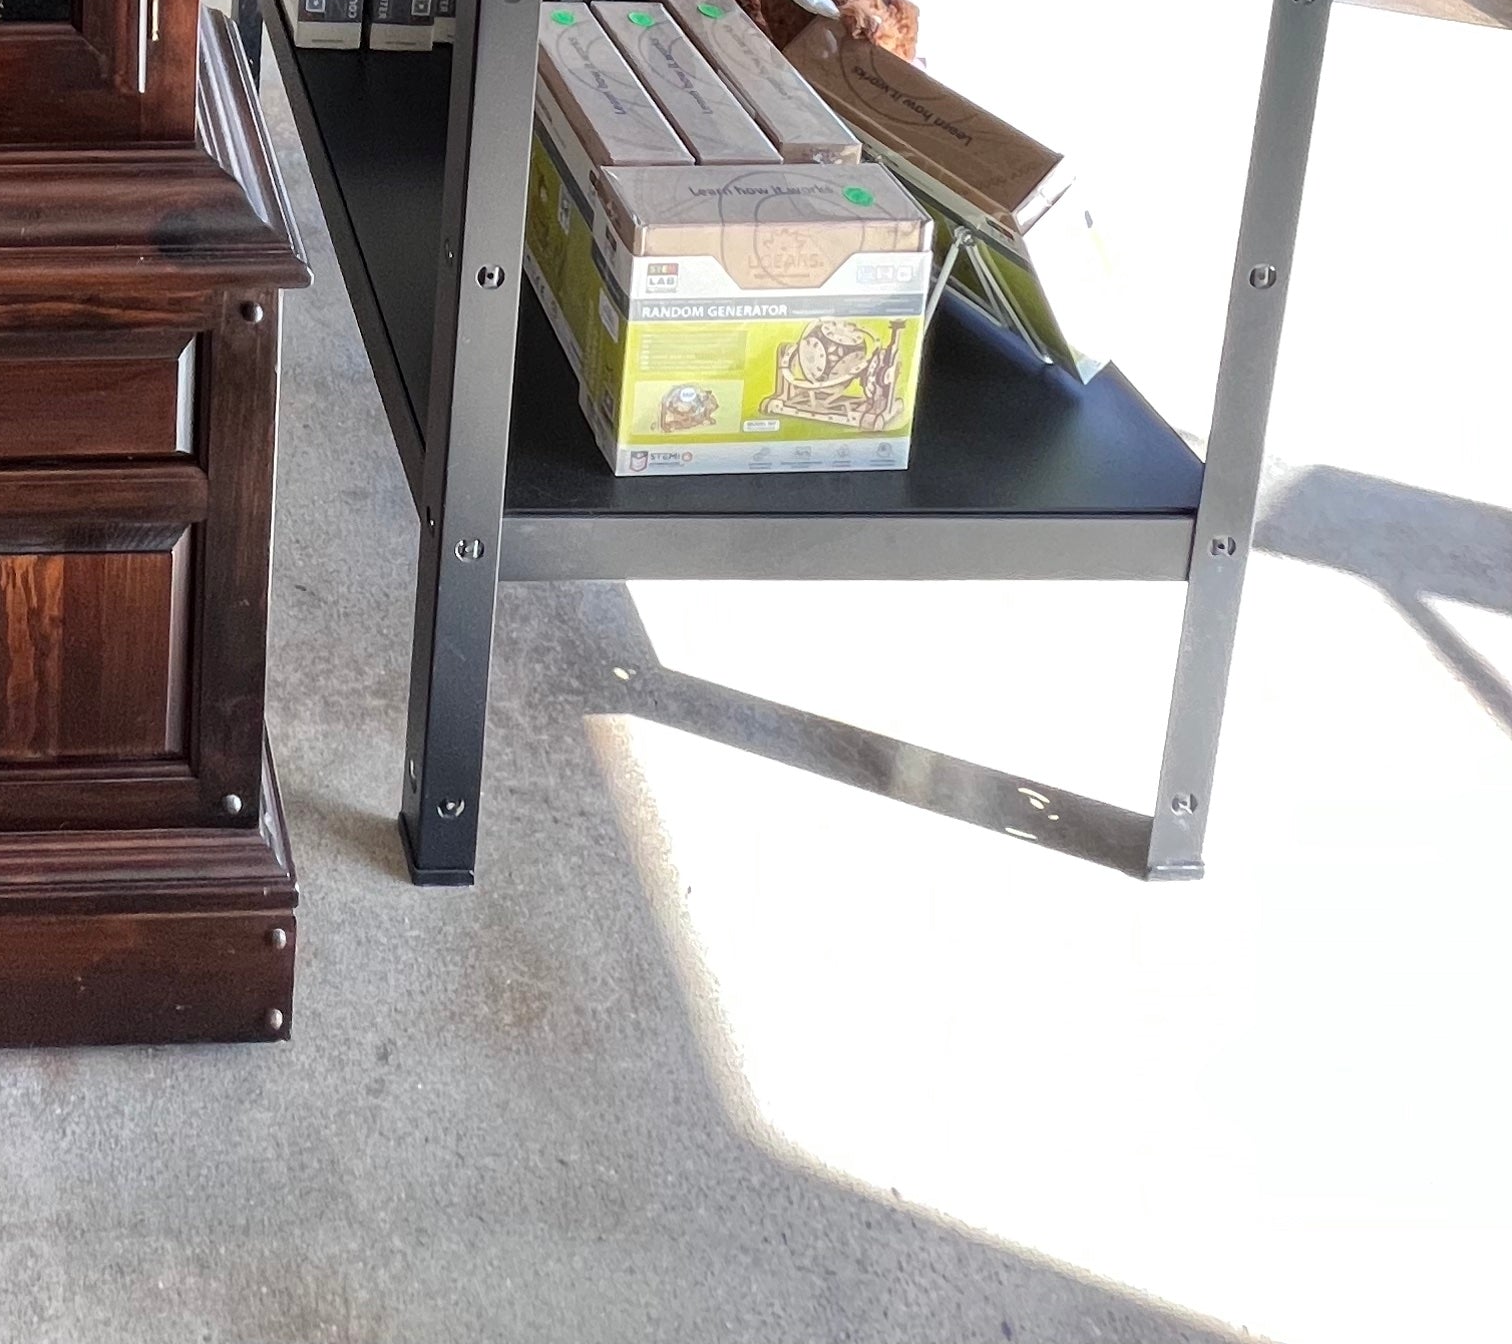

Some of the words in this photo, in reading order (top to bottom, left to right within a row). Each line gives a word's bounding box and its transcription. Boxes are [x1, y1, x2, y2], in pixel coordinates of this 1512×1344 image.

[853, 66, 891, 94] works
[902, 98, 935, 122] how
[933, 117, 973, 147] Learn
[688, 184, 733, 197] Learn
[734, 185, 769, 195] how
[786, 184, 834, 195] works
[649, 277, 675, 286] LAB
[641, 305, 704, 318] RANDOM
[708, 303, 788, 317] GENERATOR
